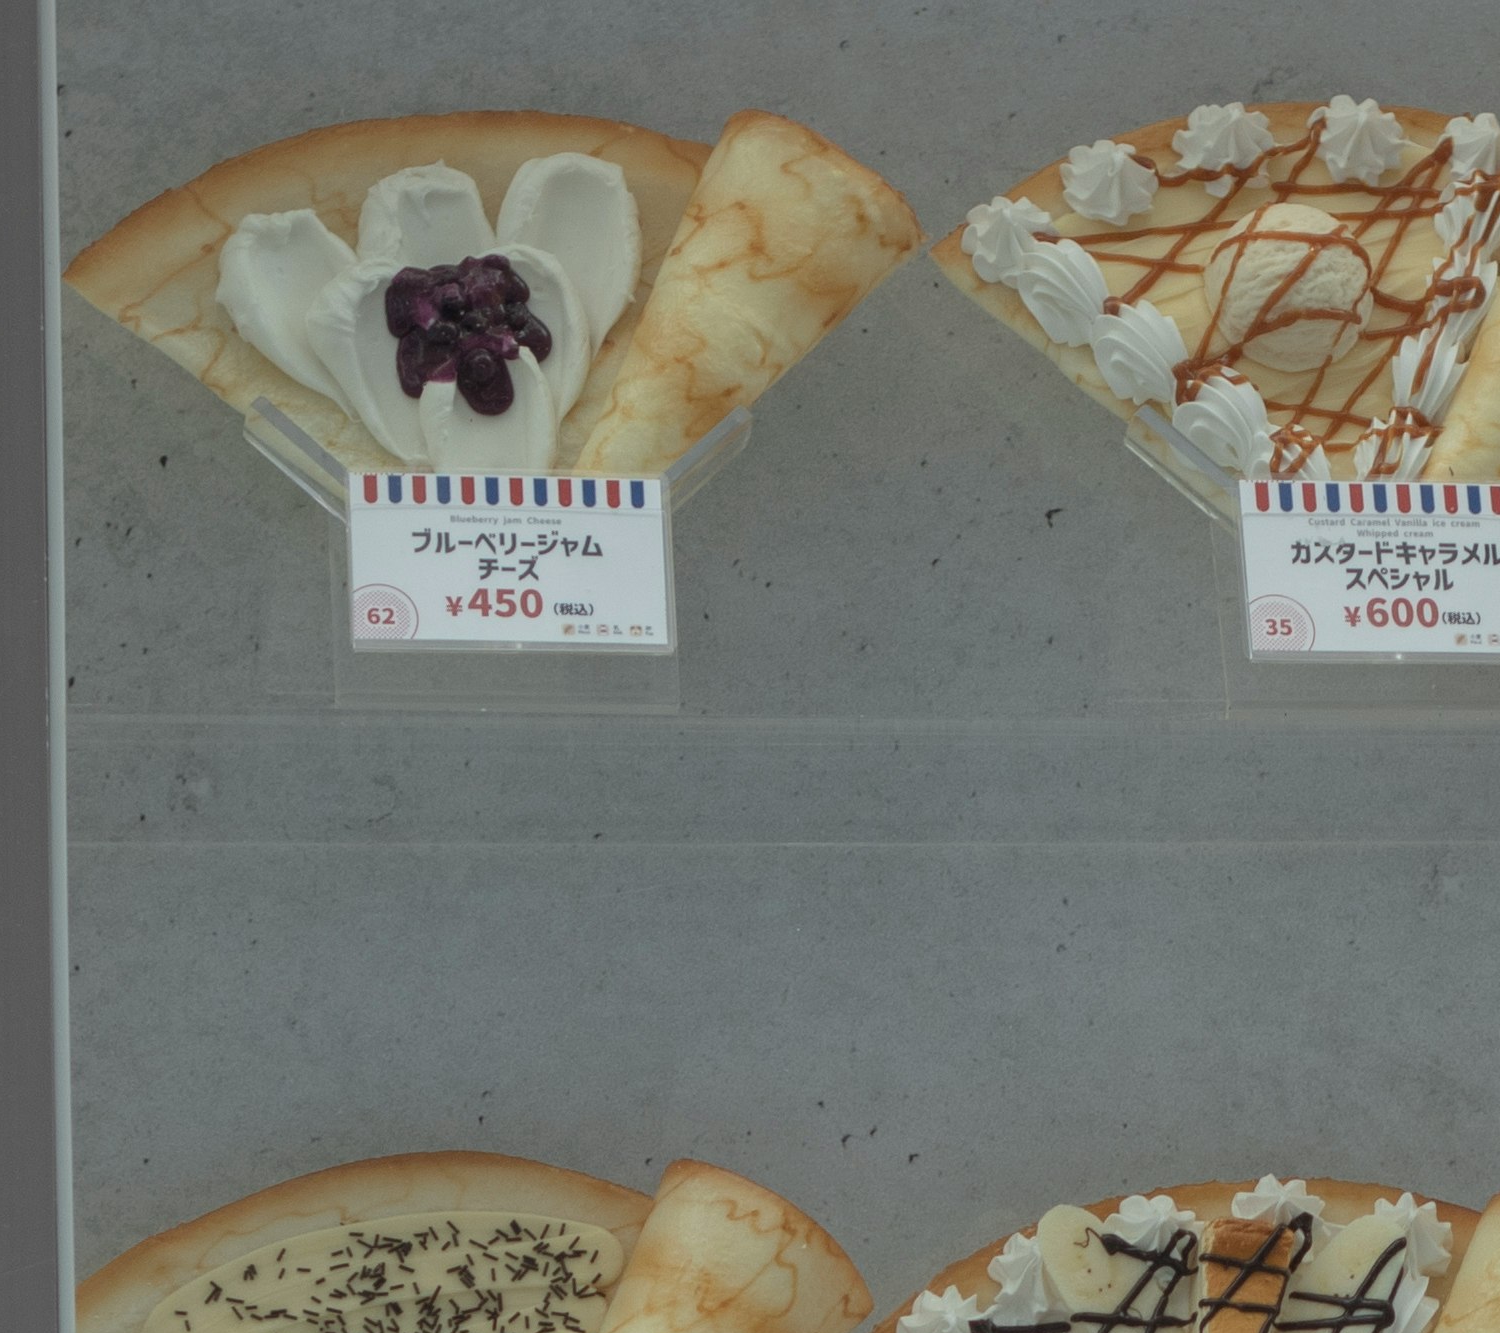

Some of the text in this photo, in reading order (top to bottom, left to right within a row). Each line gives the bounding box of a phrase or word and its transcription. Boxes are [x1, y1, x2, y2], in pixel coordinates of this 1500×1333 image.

[450, 515, 561, 525] Blueberry jam Cheese
[1308, 518, 1345, 527] Custard
[1350, 518, 1390, 527] Caramel
[1395, 518, 1427, 527] Vanilla
[1432, 520, 1446, 528] ice
[412, 528, 603, 557] ブルーベリージャム
[1357, 529, 1433, 538] Whipped cream
[478, 556, 539, 581] チーズ
[1346, 568, 1453, 592] スペシャル
[446, 589, 543, 618] ¥450
[1344, 598, 1439, 628] ¥600
[367, 608, 395, 625] 62
[1266, 619, 1292, 636] 35
